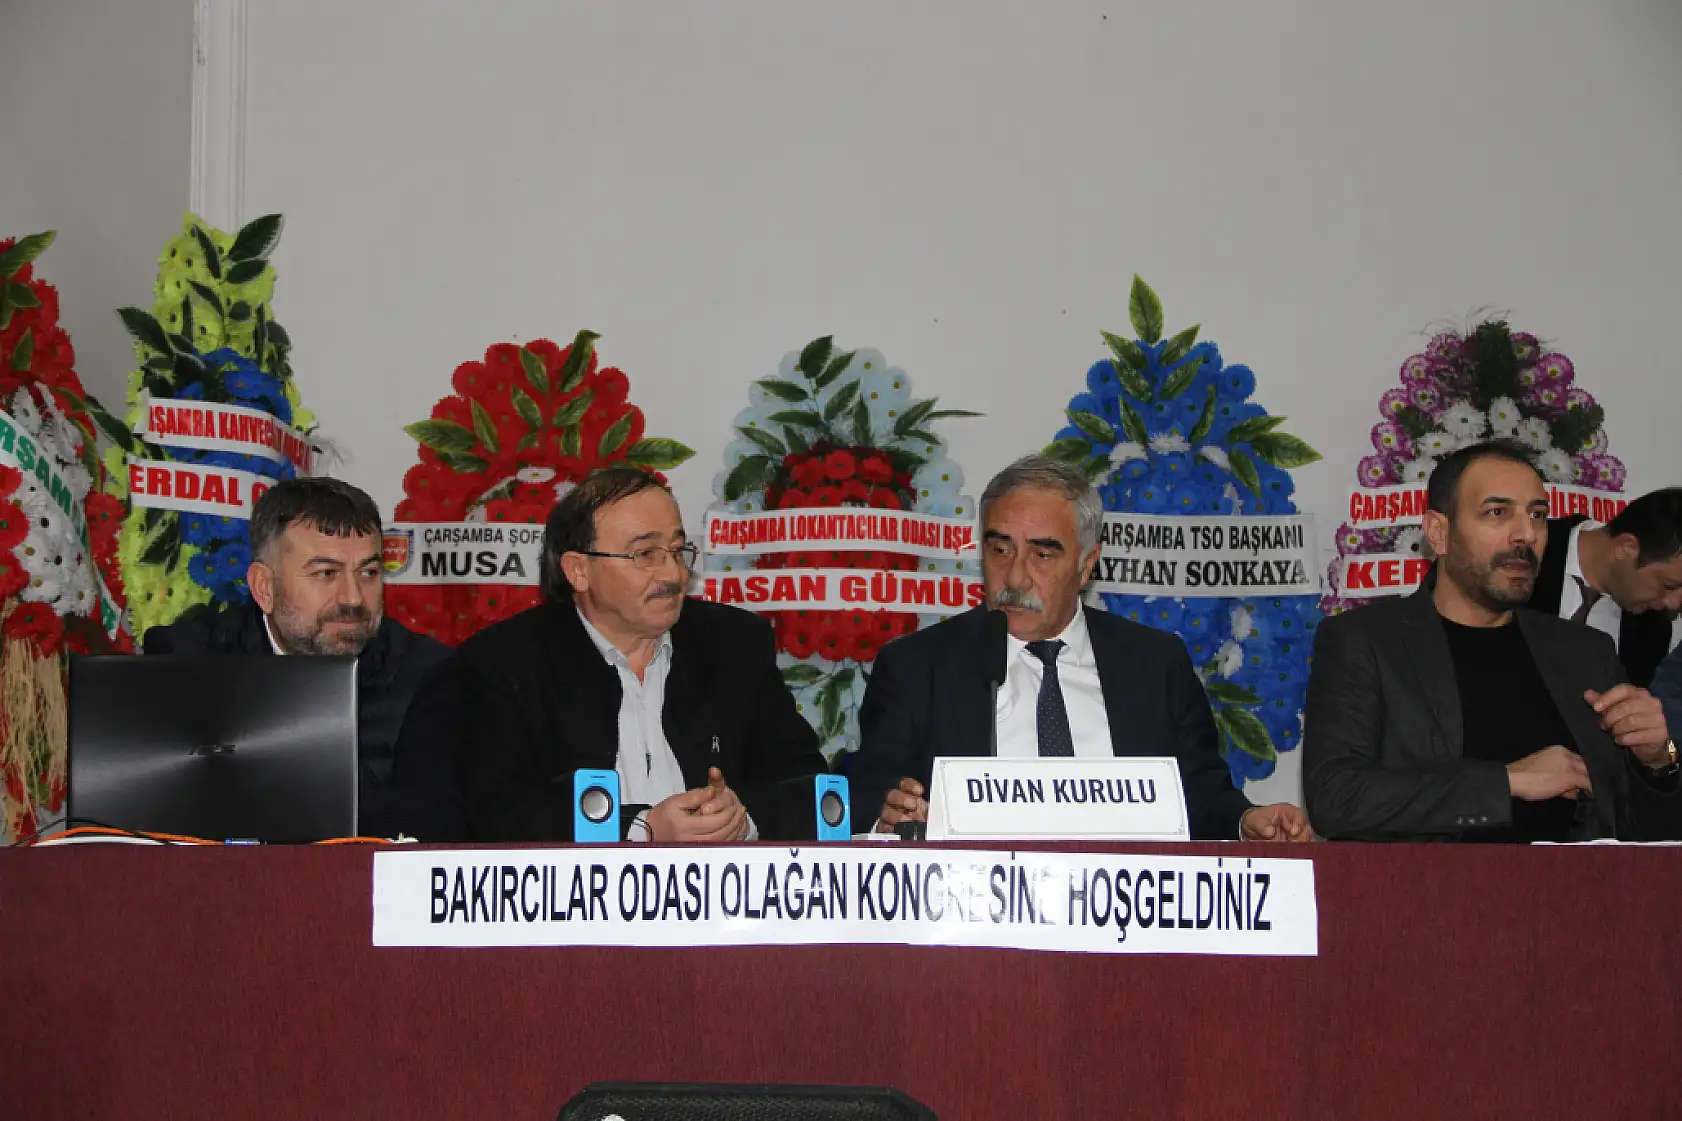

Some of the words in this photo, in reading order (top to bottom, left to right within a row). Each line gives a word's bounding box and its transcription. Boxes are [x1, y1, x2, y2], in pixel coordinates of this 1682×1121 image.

[130, 463, 243, 506] ERDAL
[424, 528, 504, 548] ÇARŞAMBA
[710, 516, 786, 549] ÇARŞAMBA
[790, 514, 898, 543] LOKANTACILAR
[901, 518, 940, 549] ODASI
[1190, 526, 1223, 549] TSO
[1229, 525, 1304, 556] BAŞKANI
[421, 551, 527, 578] MUSA
[1090, 556, 1178, 586] AYHAN
[1185, 560, 1309, 586] SONKAYA
[966, 773, 1045, 803] DİVAN
[1052, 778, 1157, 803] KURULU
[430, 864, 609, 923] BAKIRCILAR
[618, 862, 710, 922] ODASI
[720, 847, 848, 920] OLAĞAN
[1068, 857, 1271, 943] HOŞGELDİNİZ
